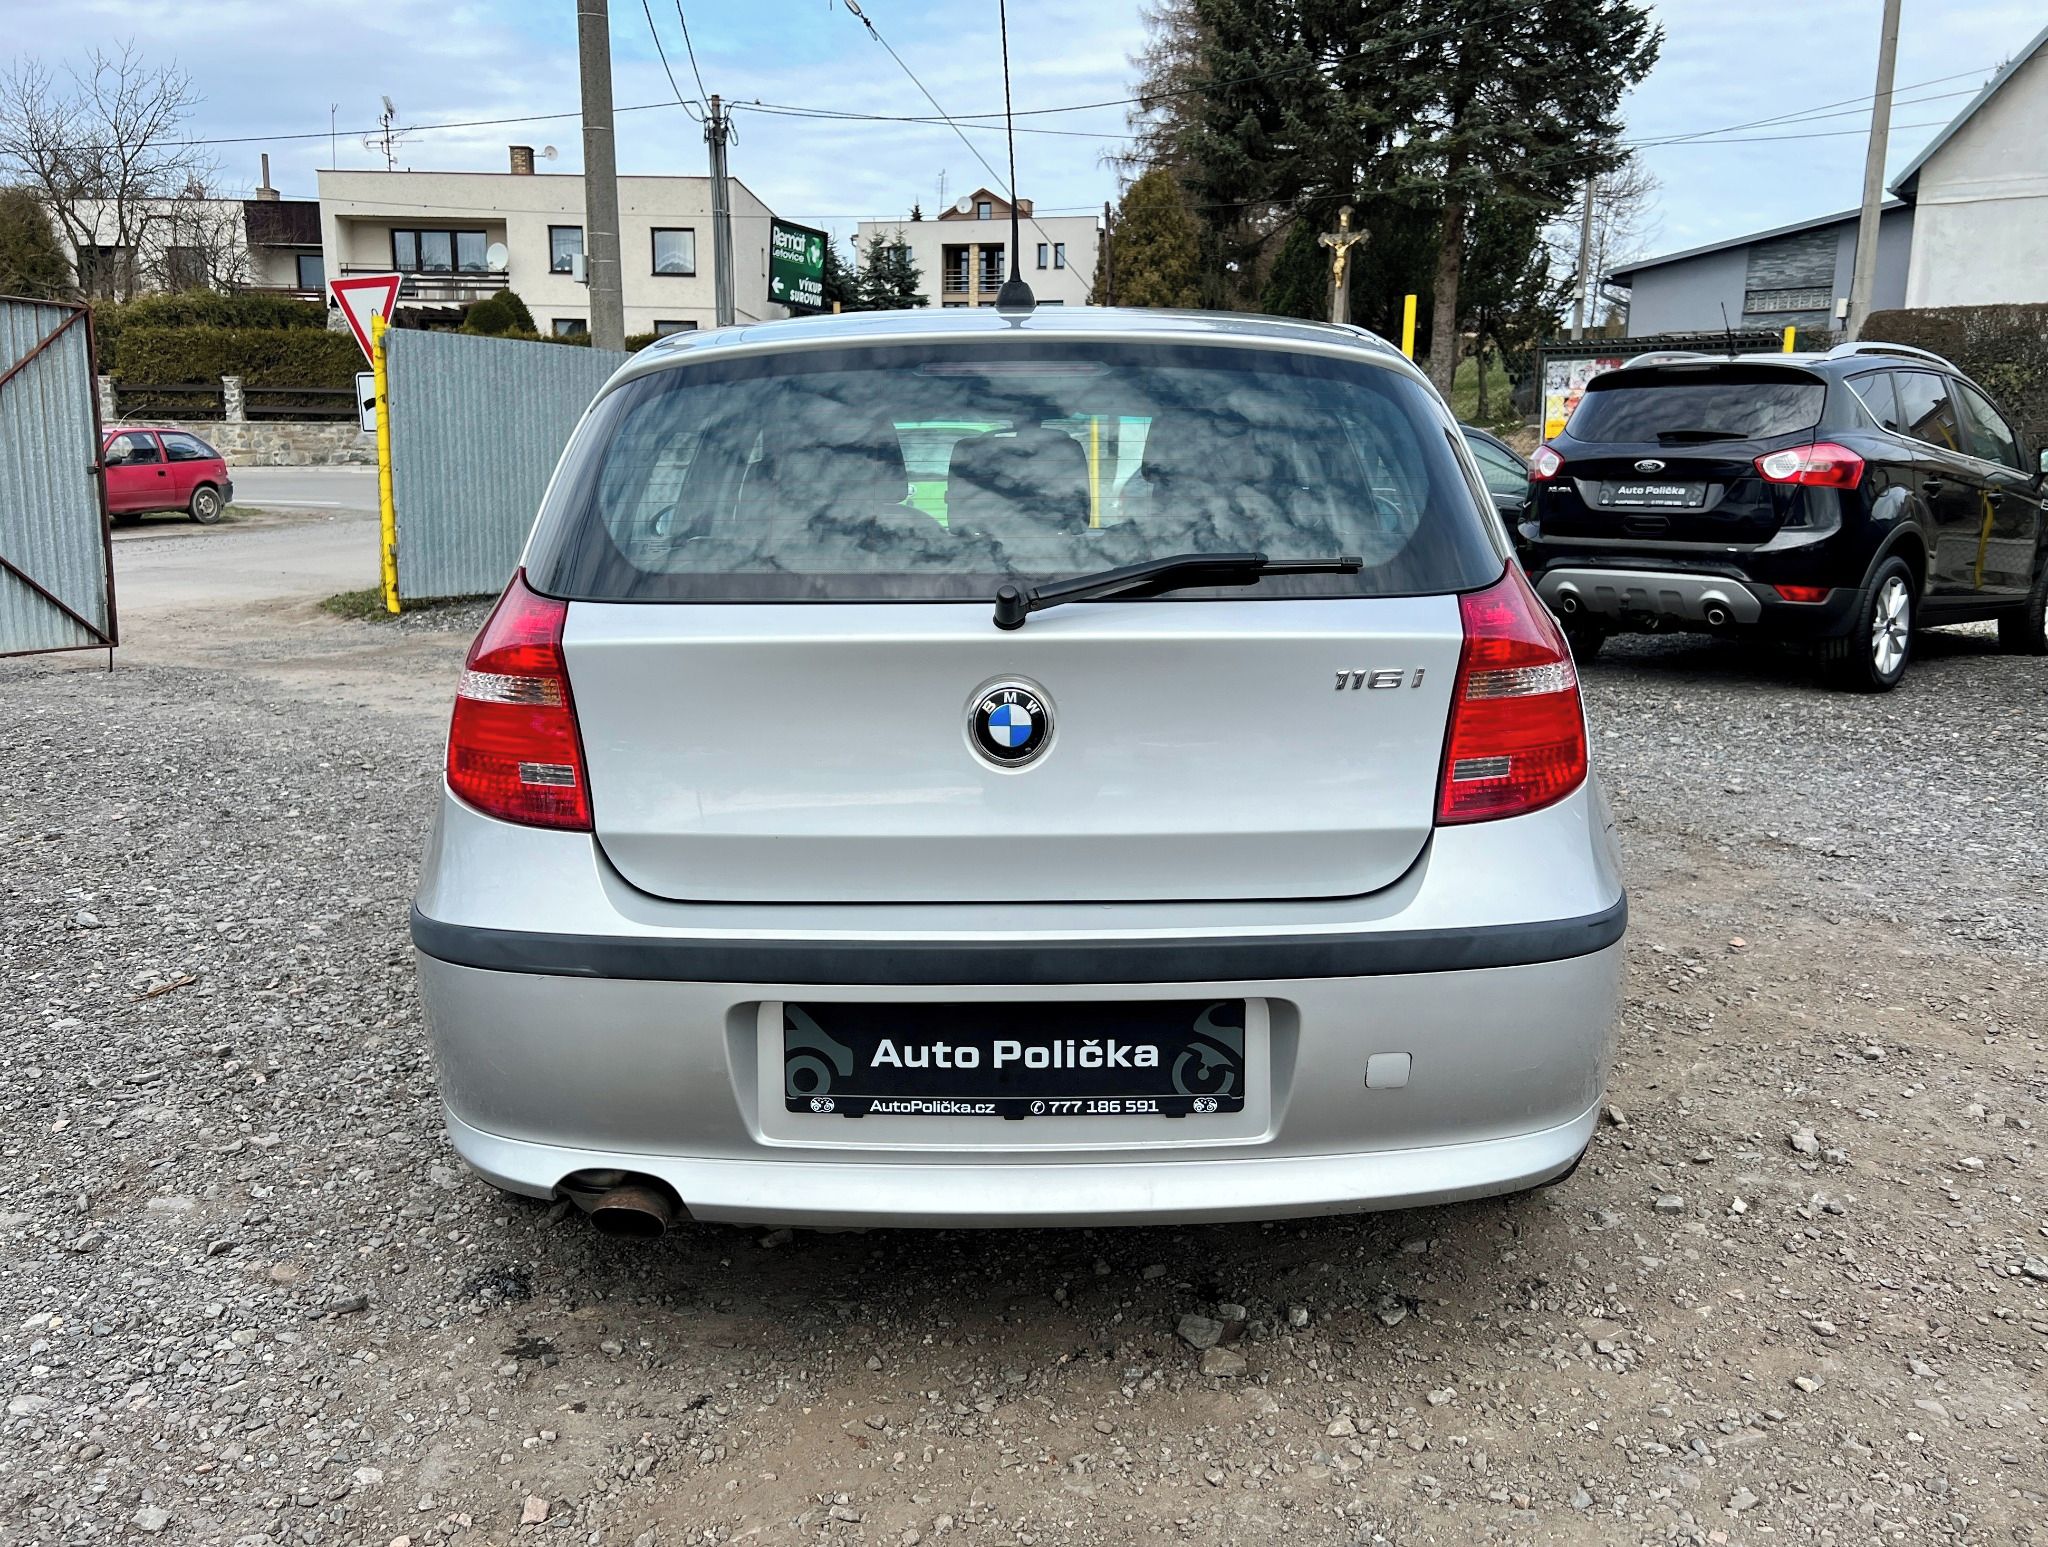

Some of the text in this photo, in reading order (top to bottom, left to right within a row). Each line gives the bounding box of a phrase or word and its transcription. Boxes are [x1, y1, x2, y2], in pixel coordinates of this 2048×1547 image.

[773, 226, 806, 252] Remat
[773, 248, 805, 263] Letovice
[799, 277, 822, 294] VÝKUP
[790, 289, 822, 306] SUROVIN
[1618, 486, 1686, 495] Auto Polička
[981, 691, 1041, 715] BMW
[870, 1039, 1159, 1069] Auto Polička
[869, 1099, 996, 1114] AutoPolička.cz
[1048, 1100, 1160, 1114] 777 186 591
